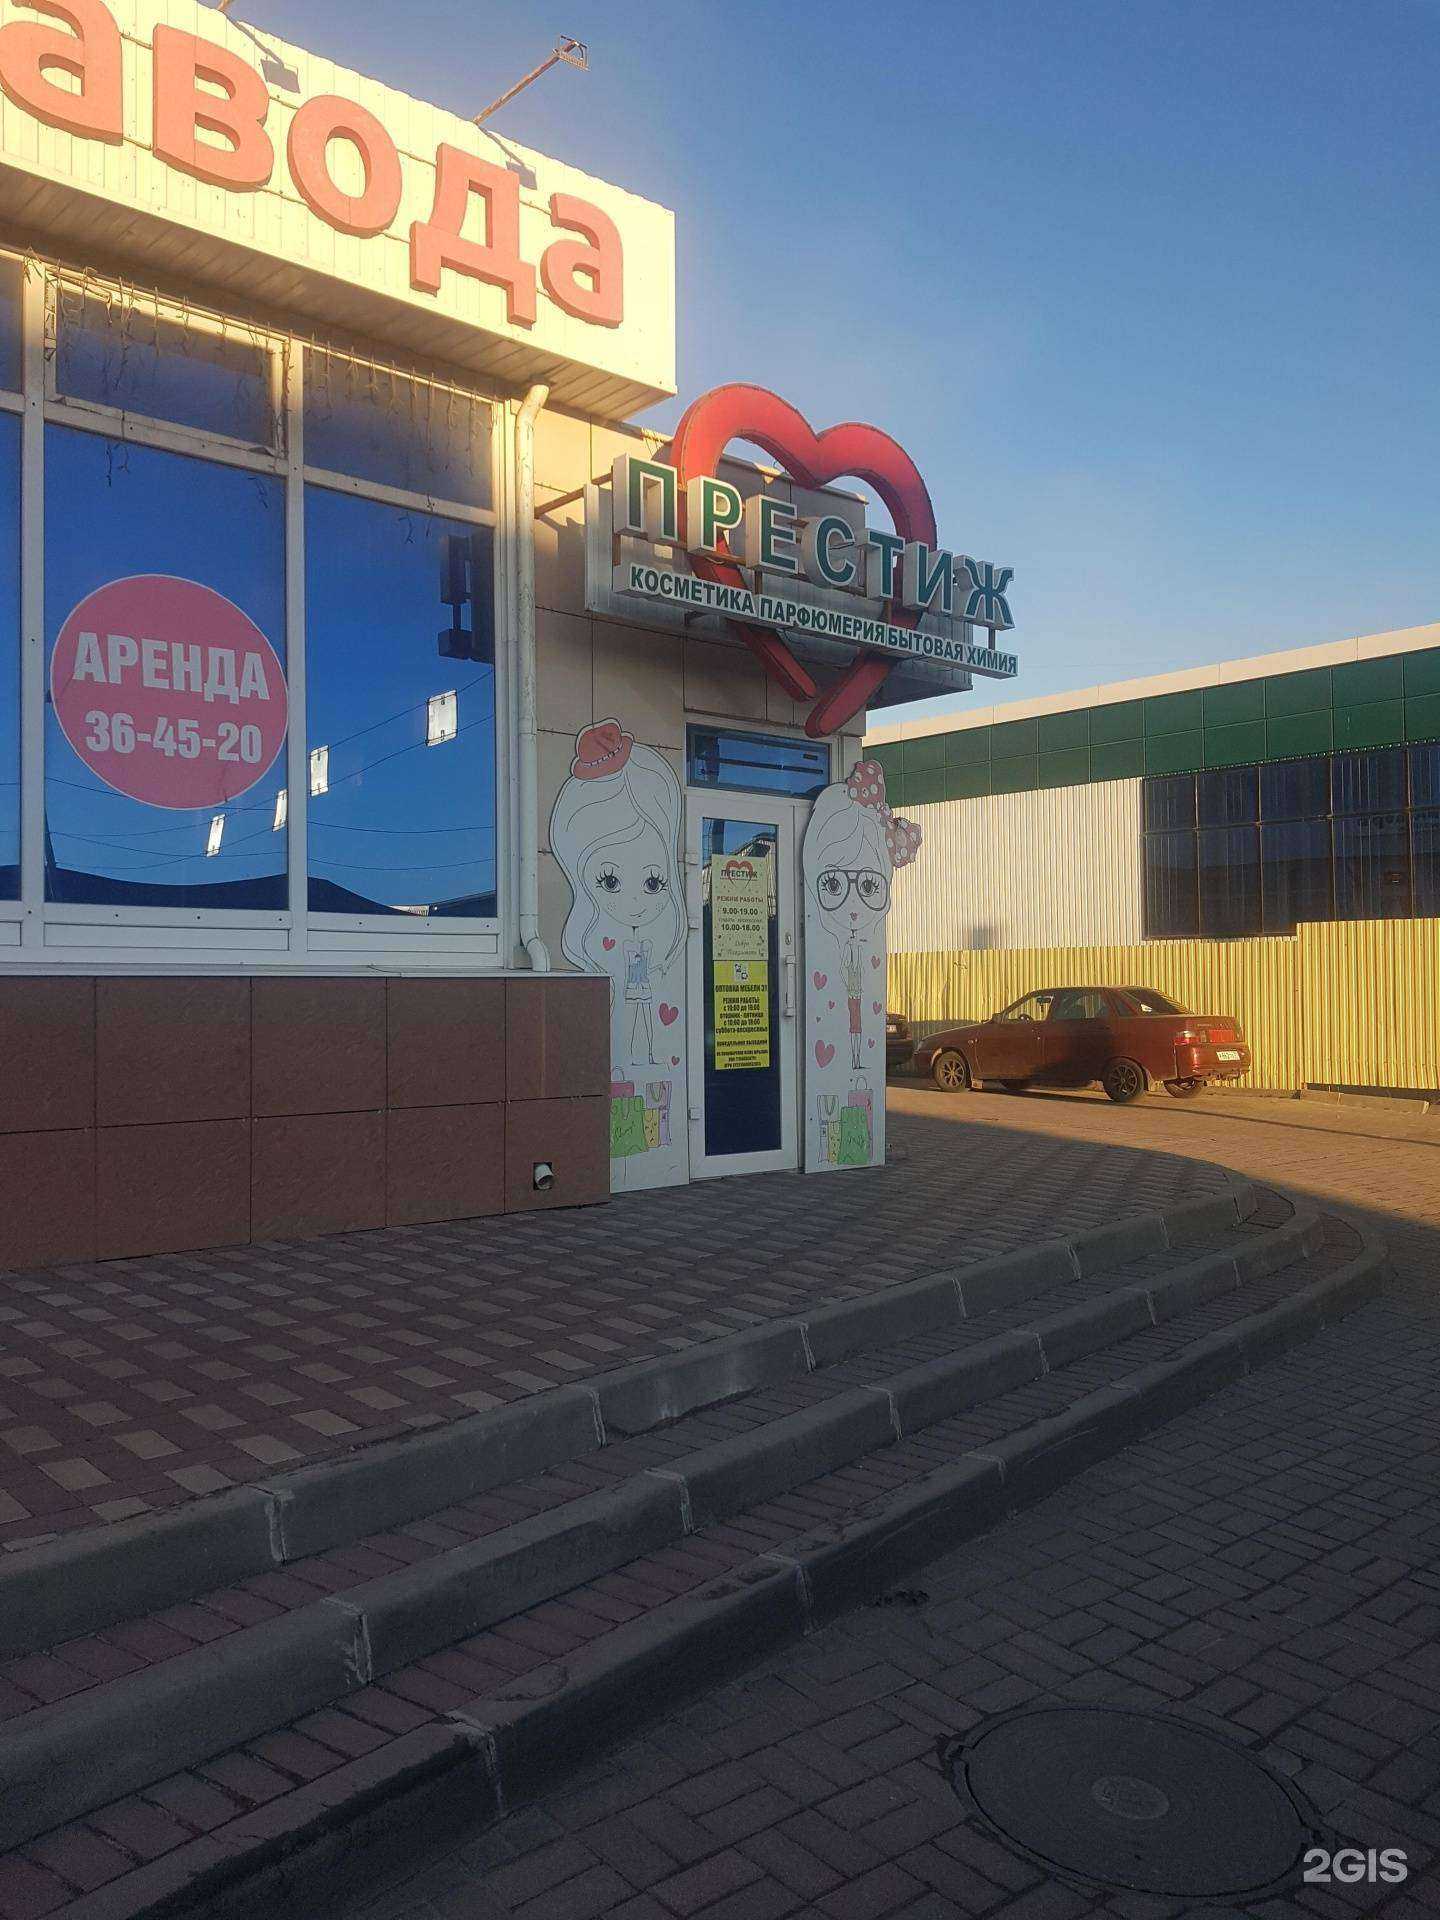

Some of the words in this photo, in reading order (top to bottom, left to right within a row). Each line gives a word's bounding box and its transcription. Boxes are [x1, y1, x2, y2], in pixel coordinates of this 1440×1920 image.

[0, 0, 624, 329] авода
[622, 453, 1015, 629] ПРЕСТИЖ
[72, 631, 270, 704] АРЕНДА
[630, 565, 755, 615] КОСМЕТИКА
[759, 598, 886, 647] ПАРФЮМЕРИЯ
[887, 630, 966, 662] БЫТОВАЯ
[967, 645, 1018, 675] ХИМИЯ
[84, 709, 262, 764] 36-45-20
